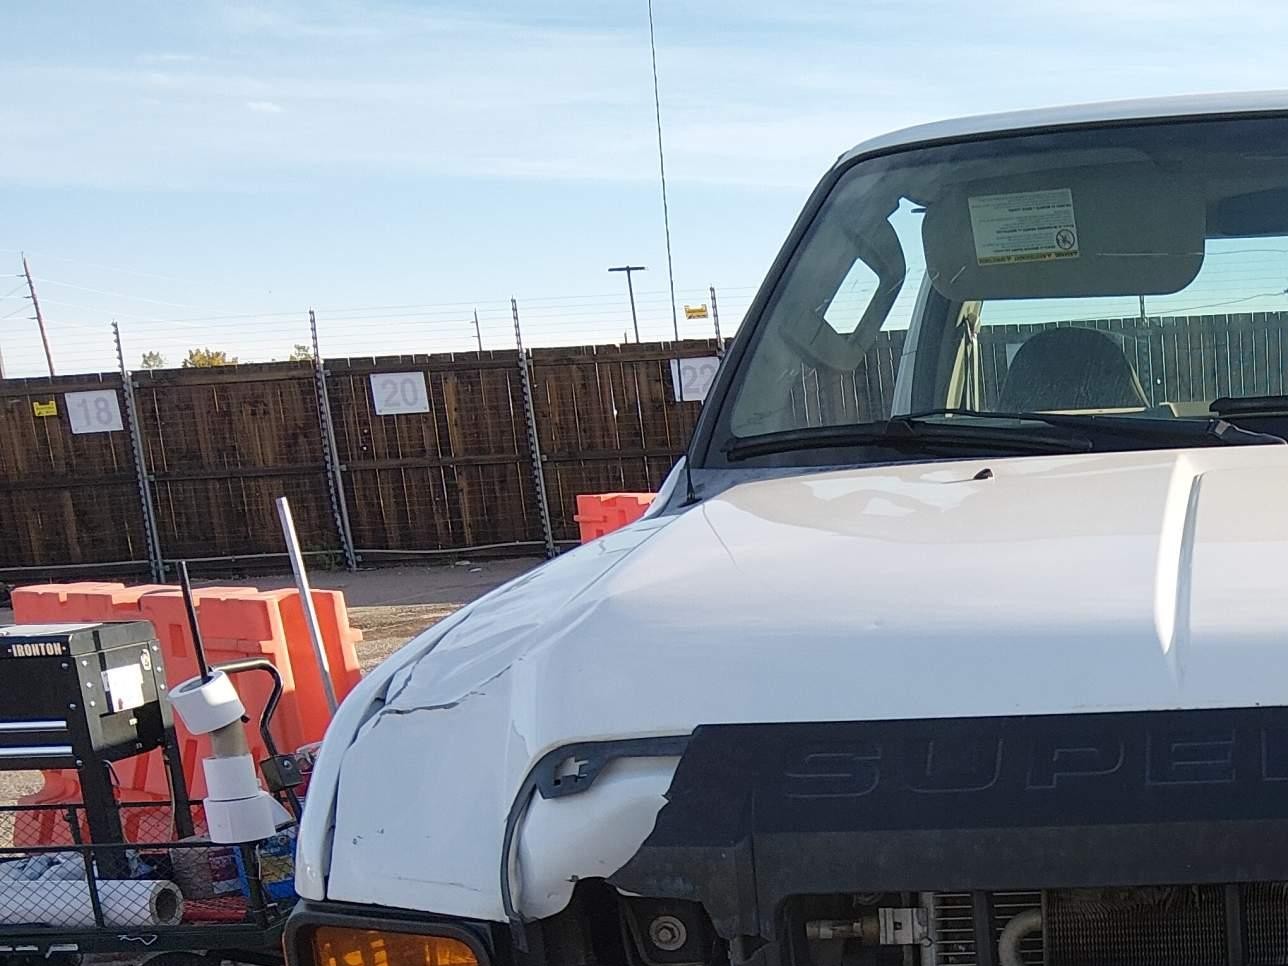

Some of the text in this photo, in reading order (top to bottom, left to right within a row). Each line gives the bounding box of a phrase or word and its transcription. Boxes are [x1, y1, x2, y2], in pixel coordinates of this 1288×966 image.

[381, 378, 419, 407] 20
[77, 397, 113, 426] 18
[12, 642, 63, 657] IRONTON
